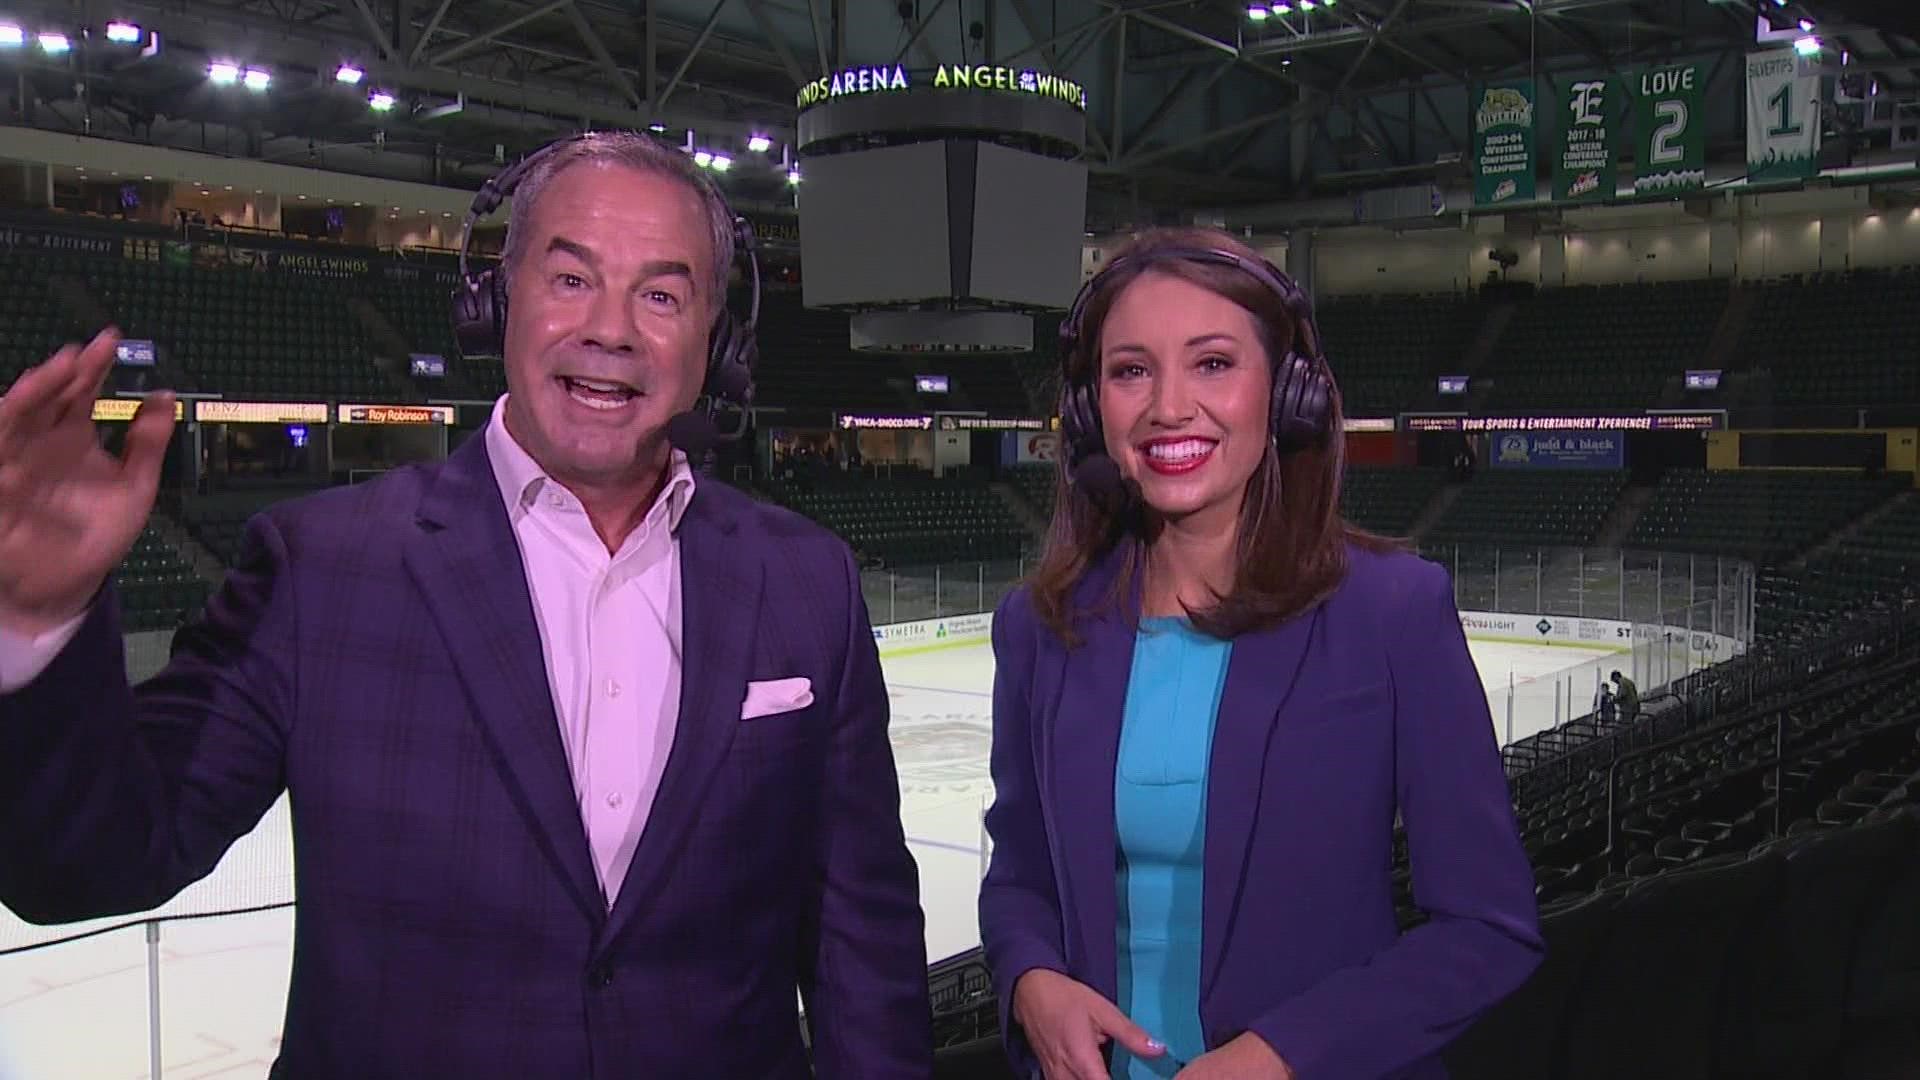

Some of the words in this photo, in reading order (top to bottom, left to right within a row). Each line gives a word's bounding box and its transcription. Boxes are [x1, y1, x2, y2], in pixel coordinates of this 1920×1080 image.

[1748, 58, 1793, 77] SILVERTIPS
[830, 63, 907, 96] ARENA
[934, 64, 1017, 90] ANGEL
[1021, 72, 1034, 81] OF
[1036, 72, 1082, 106] WINDS
[1642, 67, 1695, 96] LOVE
[1570, 81, 1605, 125] E
[1768, 82, 1803, 138] 1
[1651, 99, 1689, 164] 2
[1484, 143, 1524, 155] WESTERN
[279, 255, 319, 269] ANGEL
[328, 258, 369, 273] WINDS
[368, 409, 386, 422] Roy
[388, 409, 429, 421] Robinson
[1462, 418, 1484, 430] YOUR
[1486, 417, 1518, 430] SPORTS
[1527, 417, 1596, 430] ENTERTAINMENT
[1597, 417, 1651, 430] XPERIENCE!
[1579, 438, 1614, 449] black
[885, 624, 926, 639] SYMETRA
